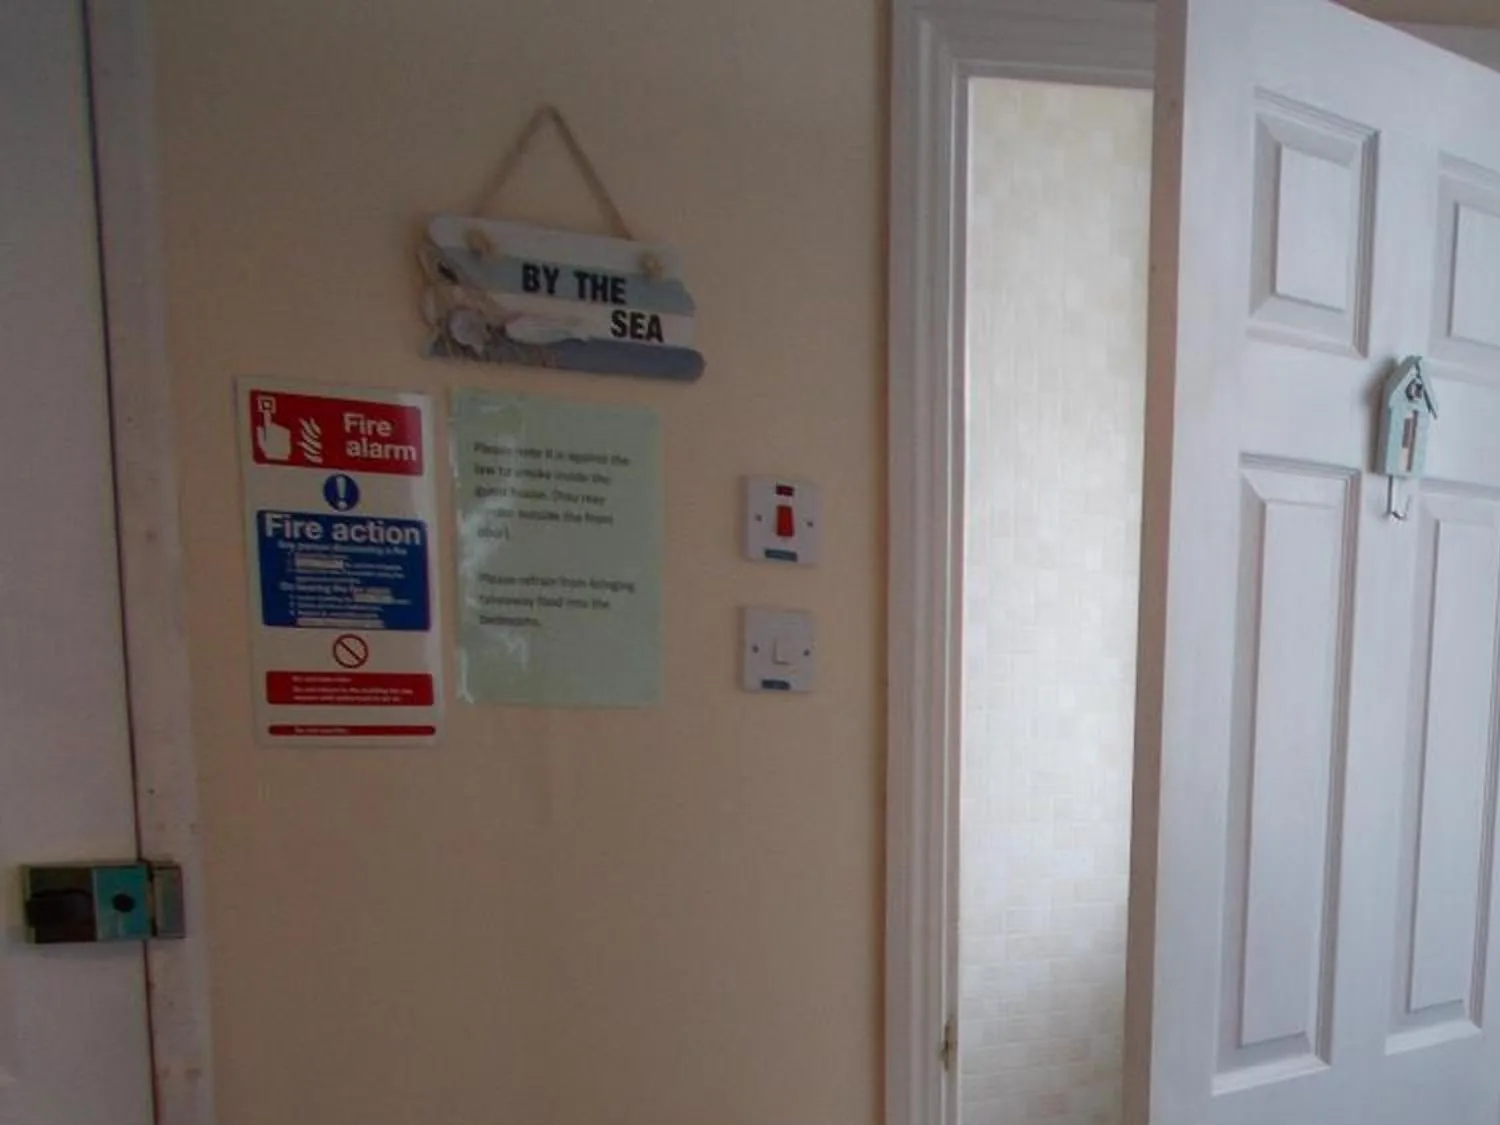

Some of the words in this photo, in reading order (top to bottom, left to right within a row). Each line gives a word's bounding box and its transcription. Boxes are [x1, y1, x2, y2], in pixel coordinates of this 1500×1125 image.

[521, 263, 560, 296] BY
[573, 270, 627, 305] THE
[611, 309, 664, 343] SEA
[342, 412, 392, 438] Fire
[346, 437, 417, 461] alarm
[264, 513, 324, 540] Fire
[331, 520, 421, 546] action
